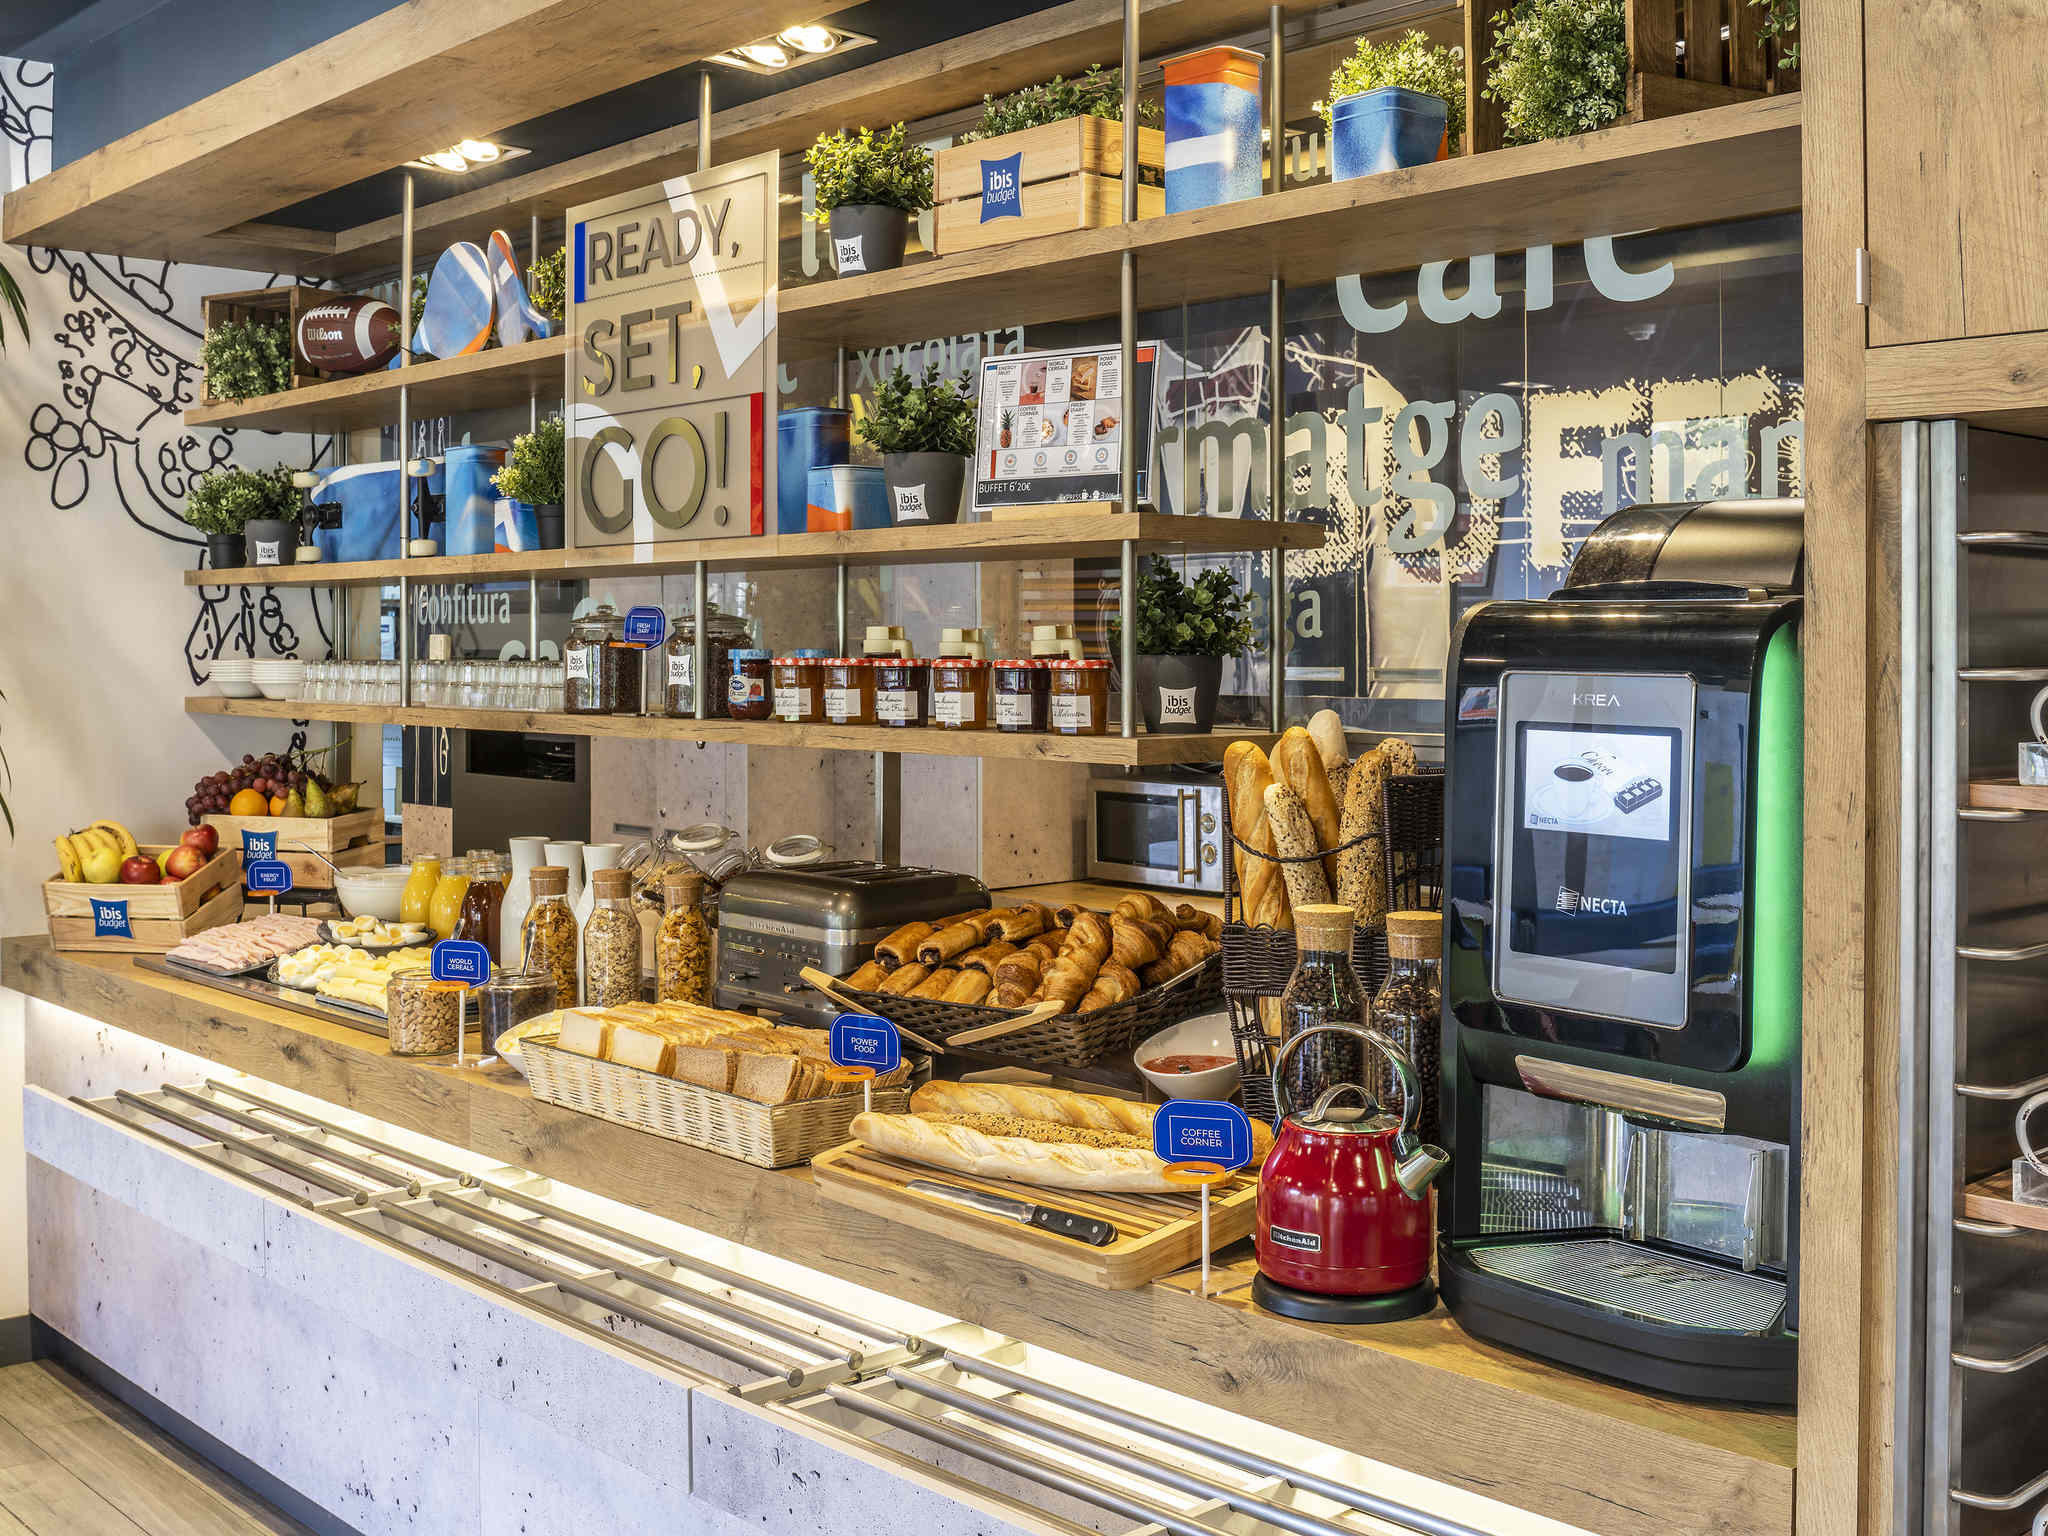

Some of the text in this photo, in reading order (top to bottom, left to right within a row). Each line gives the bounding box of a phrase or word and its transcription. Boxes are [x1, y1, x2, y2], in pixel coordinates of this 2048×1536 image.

[989, 170, 1012, 189] ibis
[986, 187, 1016, 204] budget
[588, 198, 741, 285] READY,
[840, 245, 856, 257] ibis
[840, 253, 860, 264] budget
[307, 327, 343, 340] Wilson
[582, 301, 703, 397] SET,
[581, 411, 729, 534] GO!
[979, 482, 1008, 493] BUFFET
[900, 494, 919, 505] ibis
[899, 501, 923, 512] budget
[418, 582, 512, 625] confitura
[569, 656, 583, 665] ibis
[671, 662, 685, 671] ibis
[1167, 695, 1188, 706] ibis
[1572, 693, 1621, 707] KREA
[1164, 705, 1192, 716] budget
[1538, 815, 1559, 825] NECTA
[249, 838, 270, 851] ibis
[246, 850, 273, 860] budget
[1580, 896, 1628, 916] NECTA
[100, 906, 122, 920] ibis
[99, 918, 127, 929] budget
[447, 963, 475, 971] CEREALS
[851, 1037, 879, 1046] POWER
[854, 1045, 875, 1054] FOOD
[1181, 1128, 1221, 1138] COFFEE
[1180, 1137, 1223, 1147] CORNER
[1272, 1230, 1316, 1246] KitchenAid
